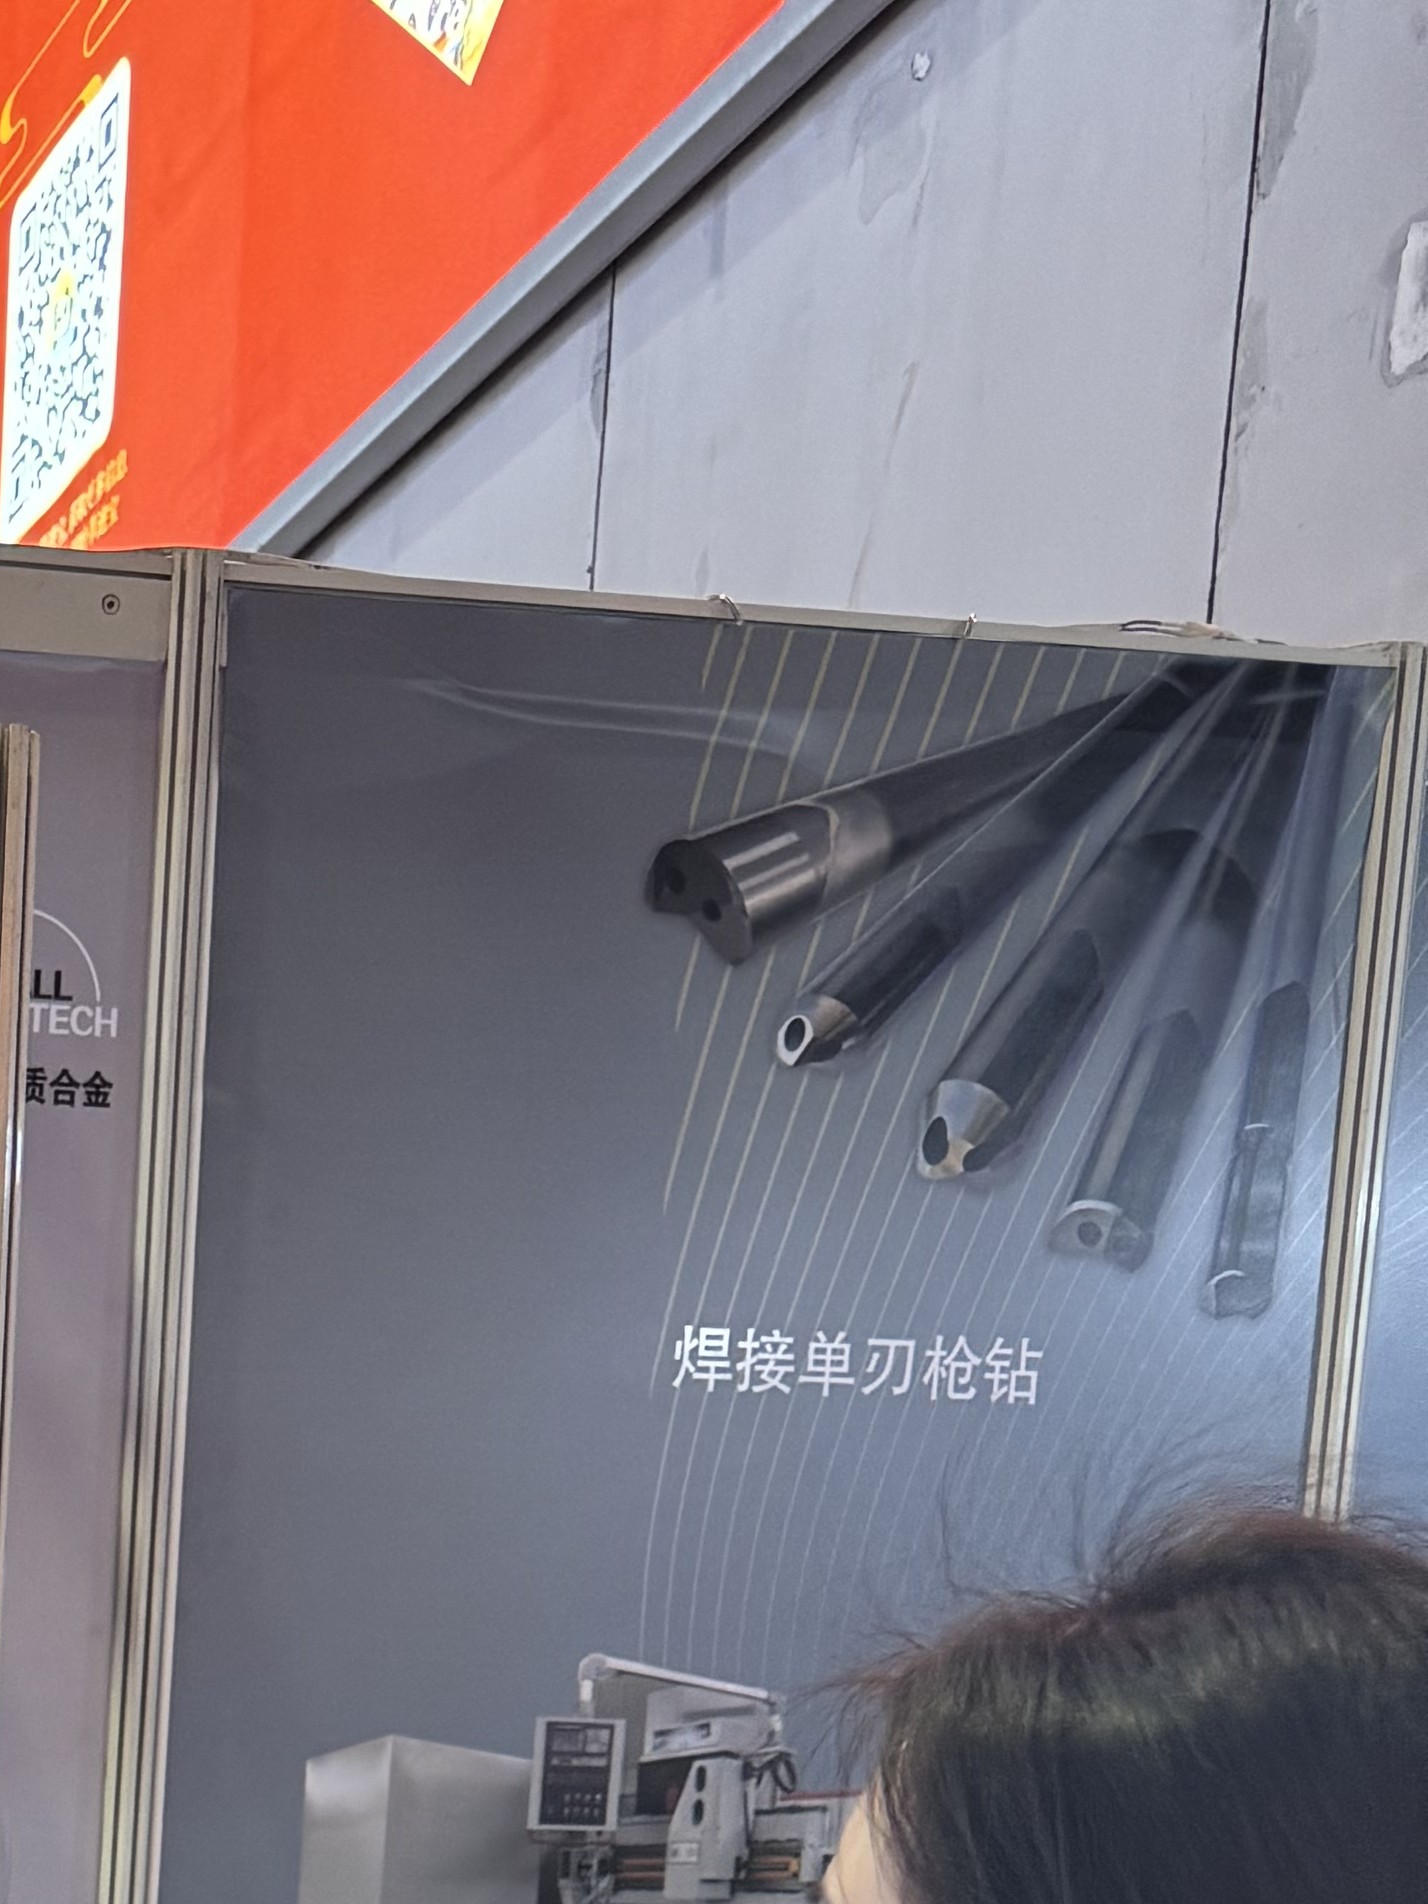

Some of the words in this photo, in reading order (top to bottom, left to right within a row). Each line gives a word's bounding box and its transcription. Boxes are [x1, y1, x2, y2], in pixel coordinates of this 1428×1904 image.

[672, 1325, 1043, 1405] 焊接单刃枪钻
